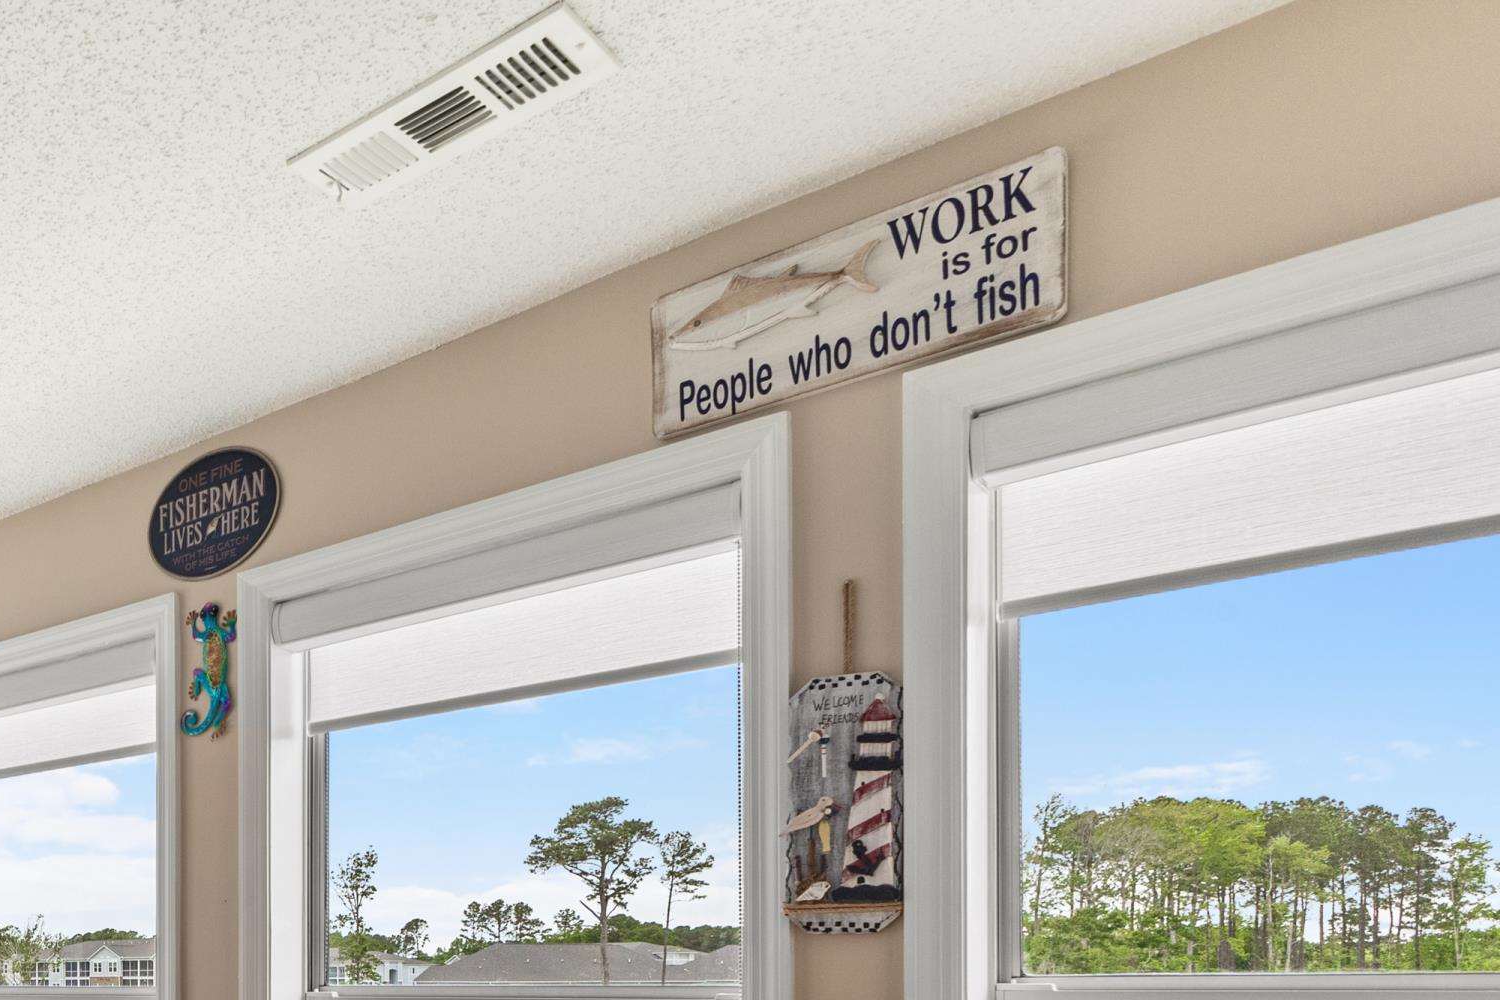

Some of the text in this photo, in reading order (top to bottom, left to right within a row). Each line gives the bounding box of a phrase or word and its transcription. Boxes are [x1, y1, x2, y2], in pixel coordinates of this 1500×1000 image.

[886, 165, 1037, 259] WORK
[941, 226, 1038, 279] is for
[679, 263, 1040, 421] People who don't fish
[179, 459, 243, 492] ONE FINE
[159, 468, 265, 532] FISHERMAN
[164, 501, 260, 555] LIVES HERE
[198, 544, 215, 557] THE
[217, 534, 249, 551] CATCH
[185, 560, 197, 571] OF
[216, 549, 237, 561] LIFE
[812, 694, 864, 711] WELCOME
[821, 712, 859, 725] FRIENDS
